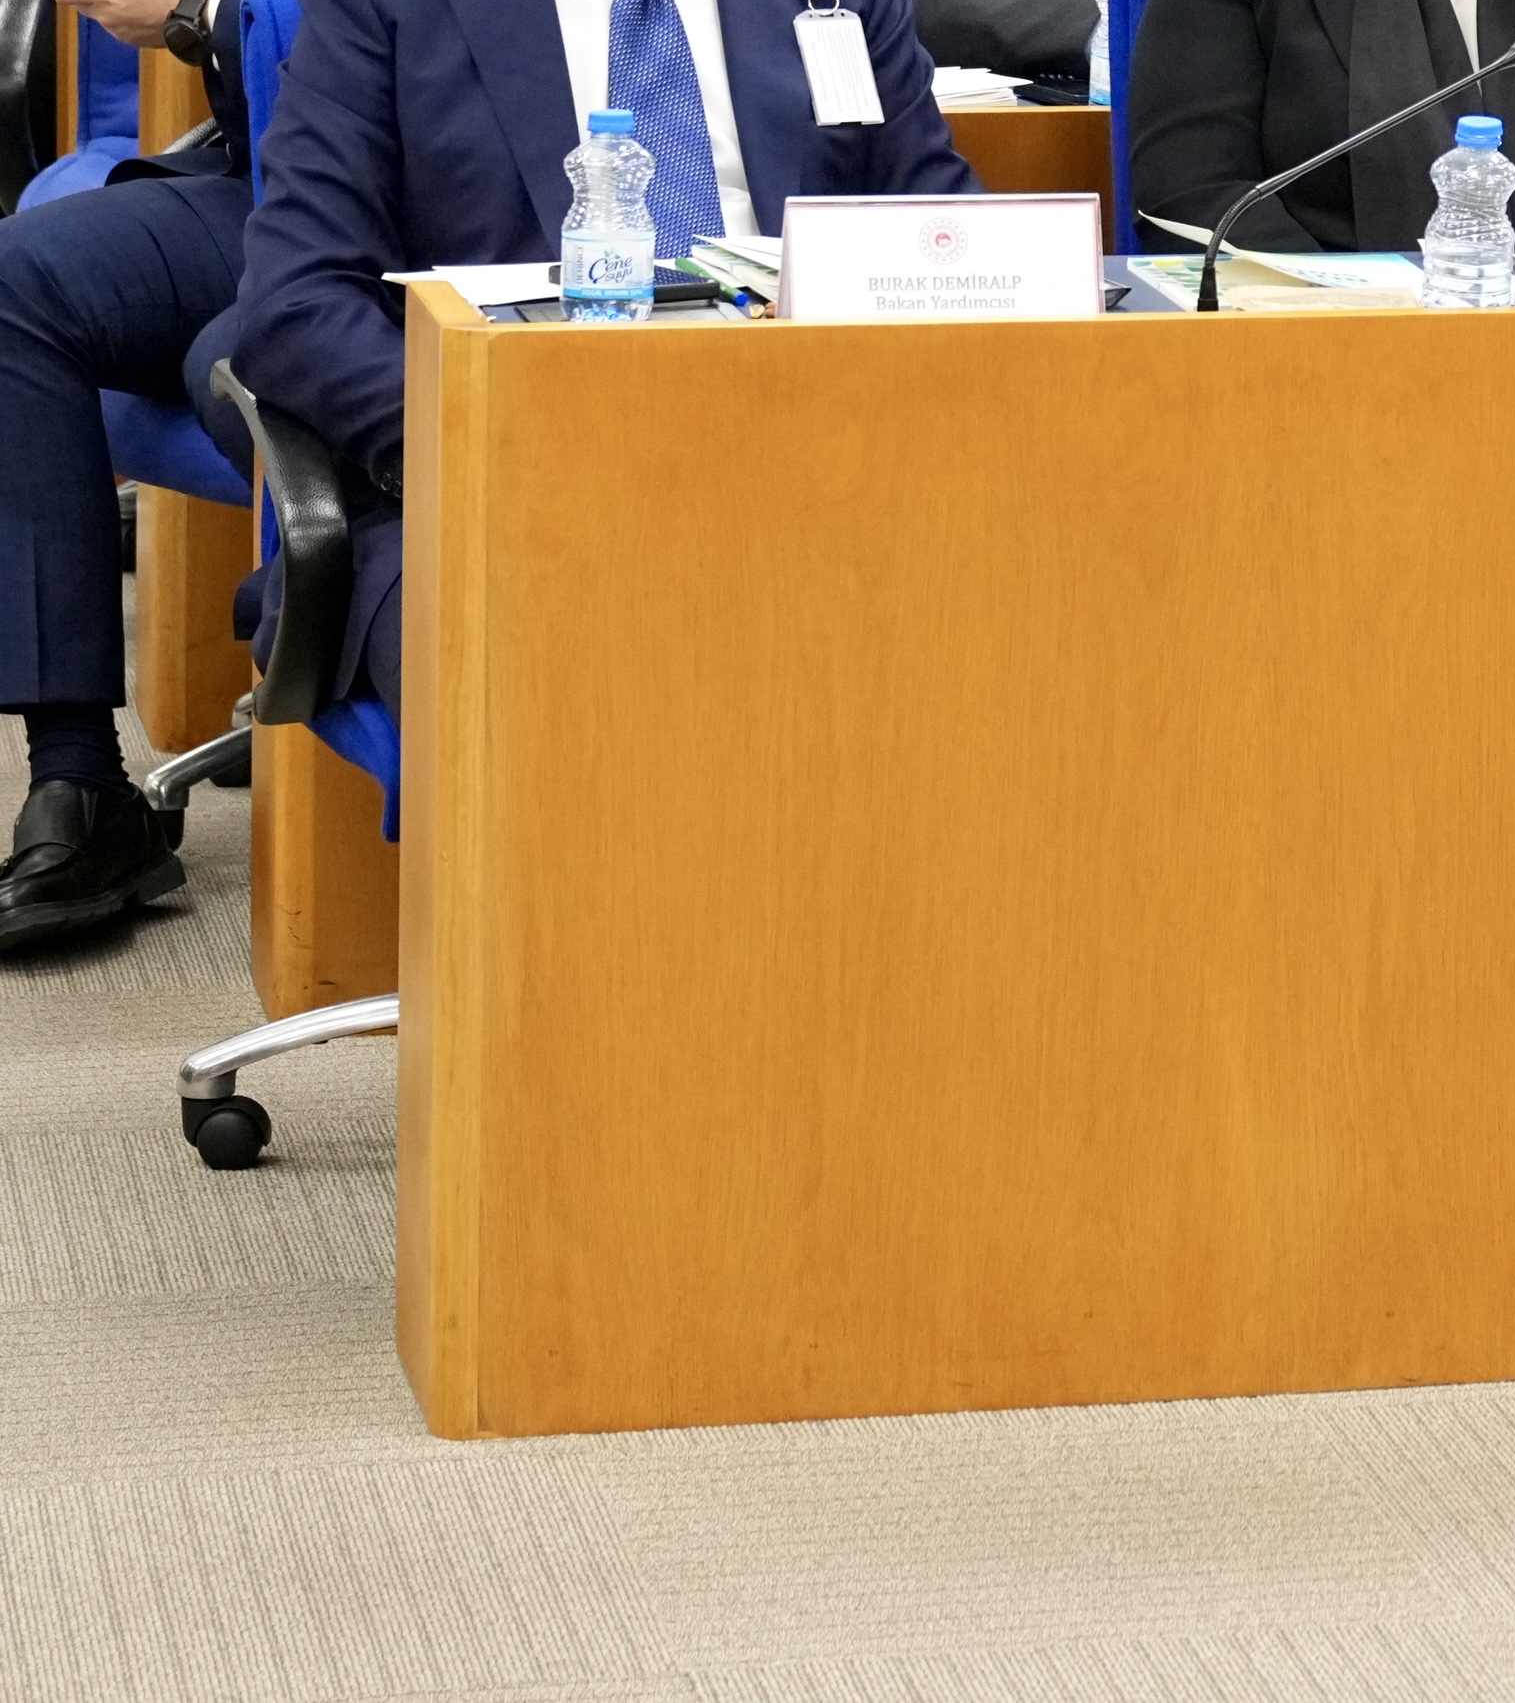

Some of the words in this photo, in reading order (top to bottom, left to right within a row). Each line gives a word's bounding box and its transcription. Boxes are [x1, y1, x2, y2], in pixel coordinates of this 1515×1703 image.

[588, 256, 633, 285] Çene
[605, 267, 633, 284] suyu
[868, 276, 928, 292] BURAK
[932, 273, 1022, 291] DEMİRALP
[876, 295, 926, 310] Bakan
[930, 294, 1016, 310] Yardımcısı
